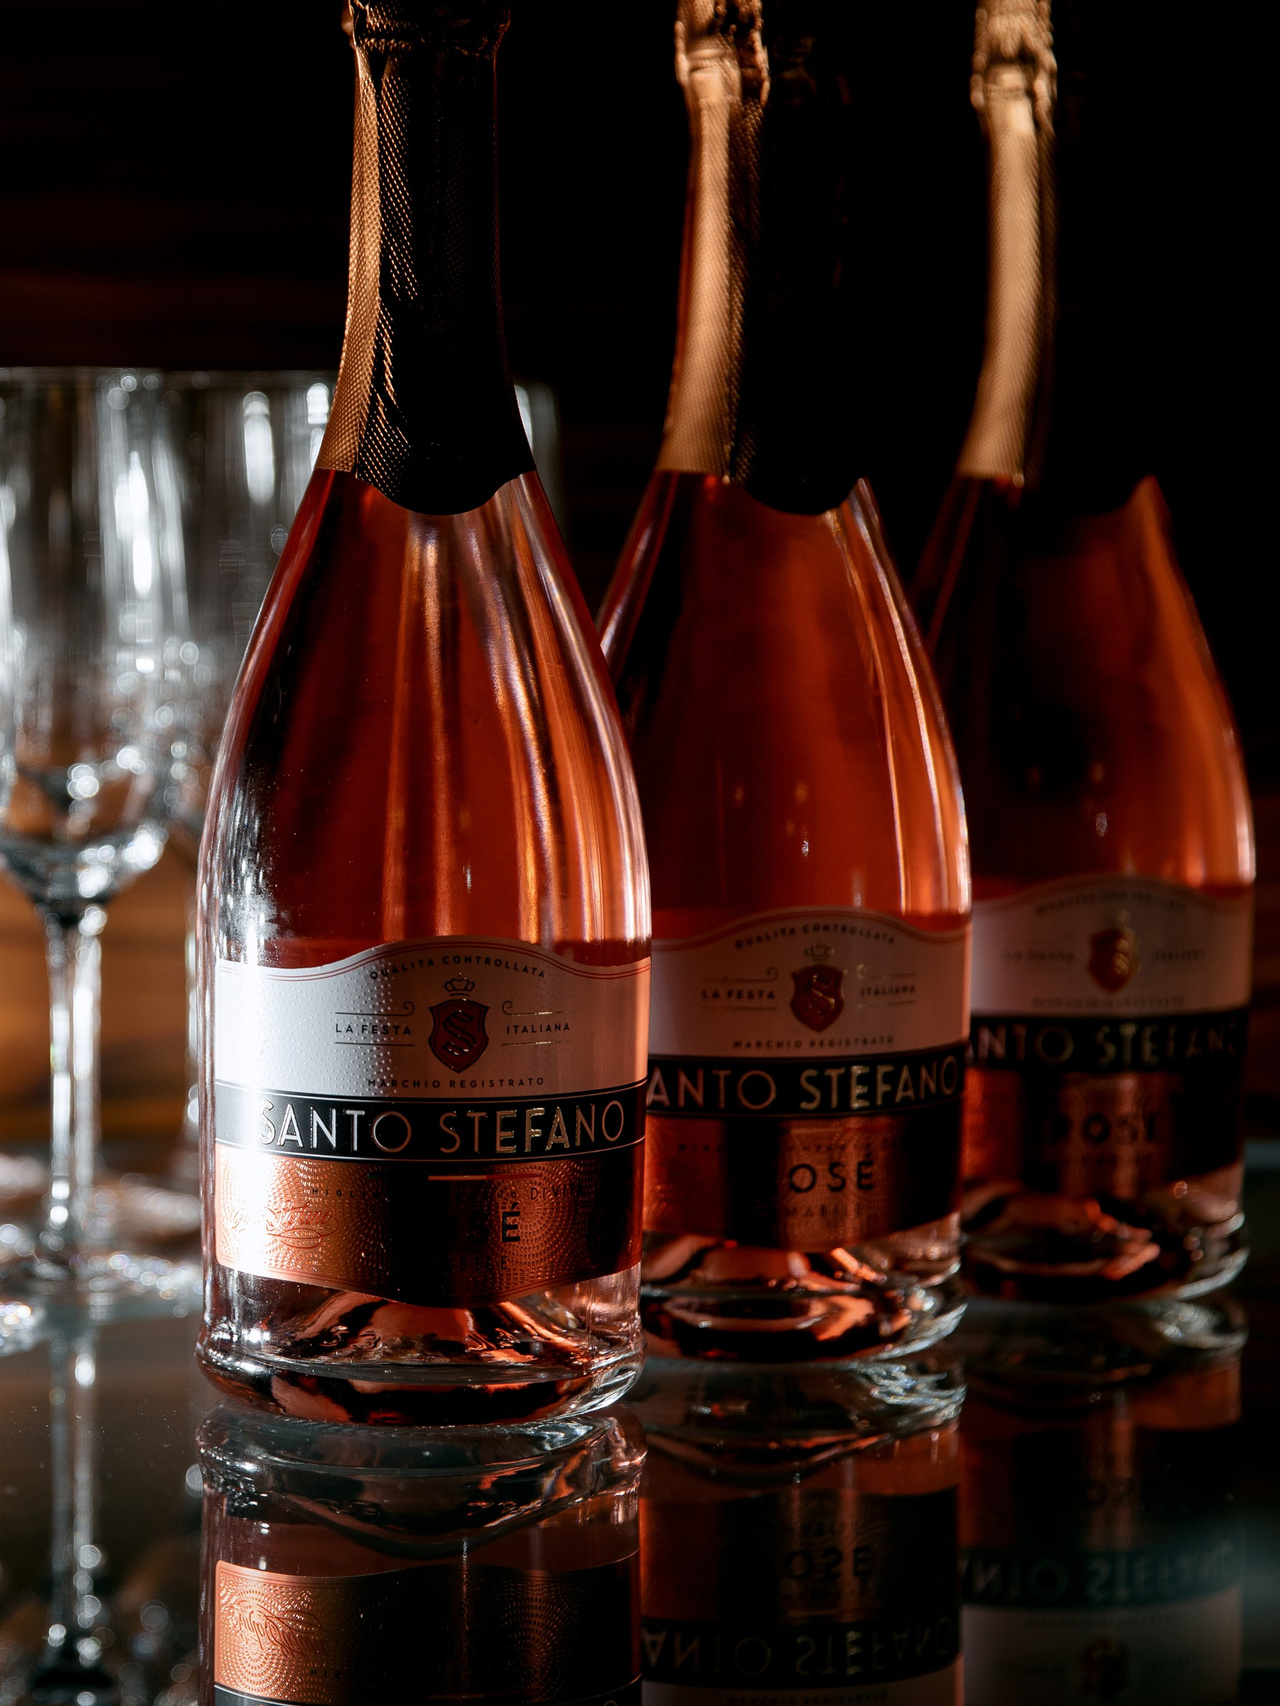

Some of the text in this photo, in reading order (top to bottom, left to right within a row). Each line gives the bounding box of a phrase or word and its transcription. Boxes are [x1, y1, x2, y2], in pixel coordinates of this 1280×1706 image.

[441, 955, 545, 979] CONTROLLATA
[702, 989, 776, 1000] LA FESTA
[335, 1023, 412, 1036] LA FESTA
[506, 1022, 571, 1034] ITALIANA
[368, 1076, 544, 1088] MARCHIO REGISTRATO
[646, 1055, 959, 1111] ANTO STEFANO
[260, 1100, 625, 1154] SANTO STEFANO
[789, 1152, 874, 1193] OSÉ
